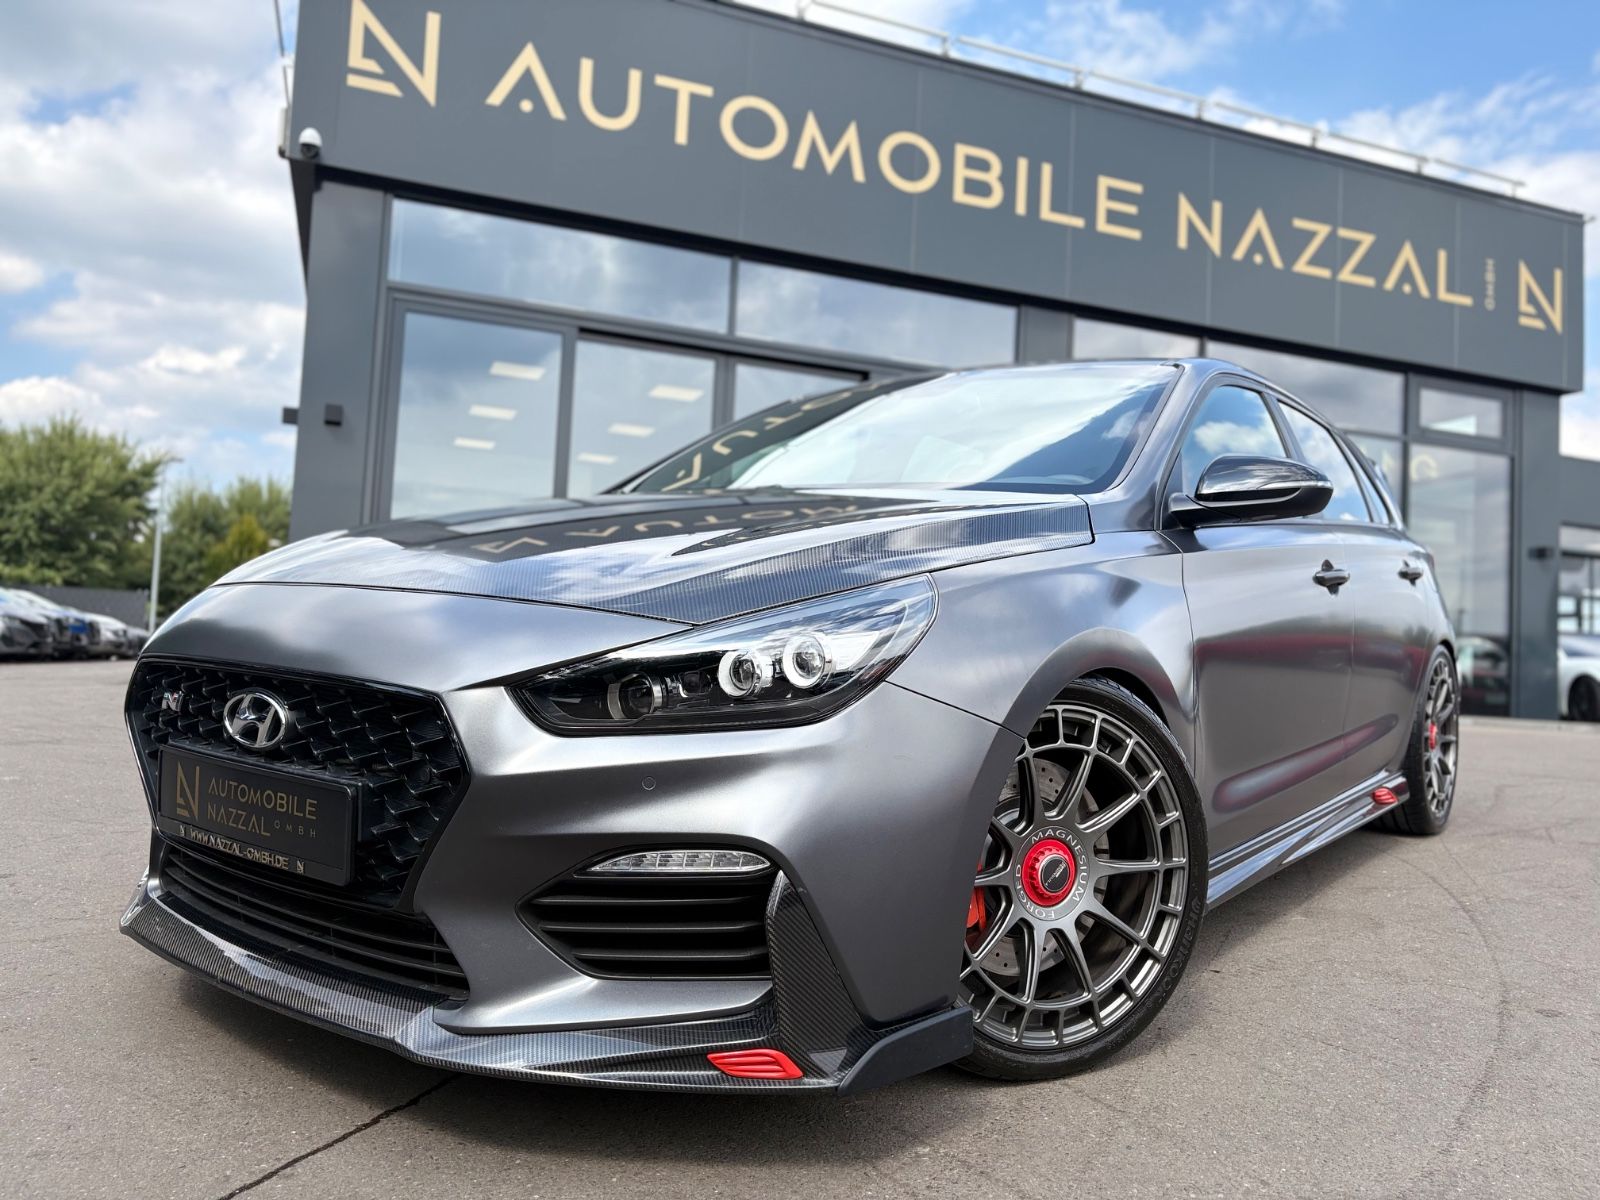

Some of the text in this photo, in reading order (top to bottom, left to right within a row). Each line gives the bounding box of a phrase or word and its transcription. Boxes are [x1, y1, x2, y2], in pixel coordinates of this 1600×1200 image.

[484, 41, 1142, 242] AUTOMOBILE
[1177, 192, 1474, 308] NAZZAL
[207, 803, 271, 837] NAZZAL
[208, 777, 318, 820] AUTOMOBILE
[1015, 864, 1055, 920] FORGED
[1031, 828, 1088, 902] MAGNESIUM
